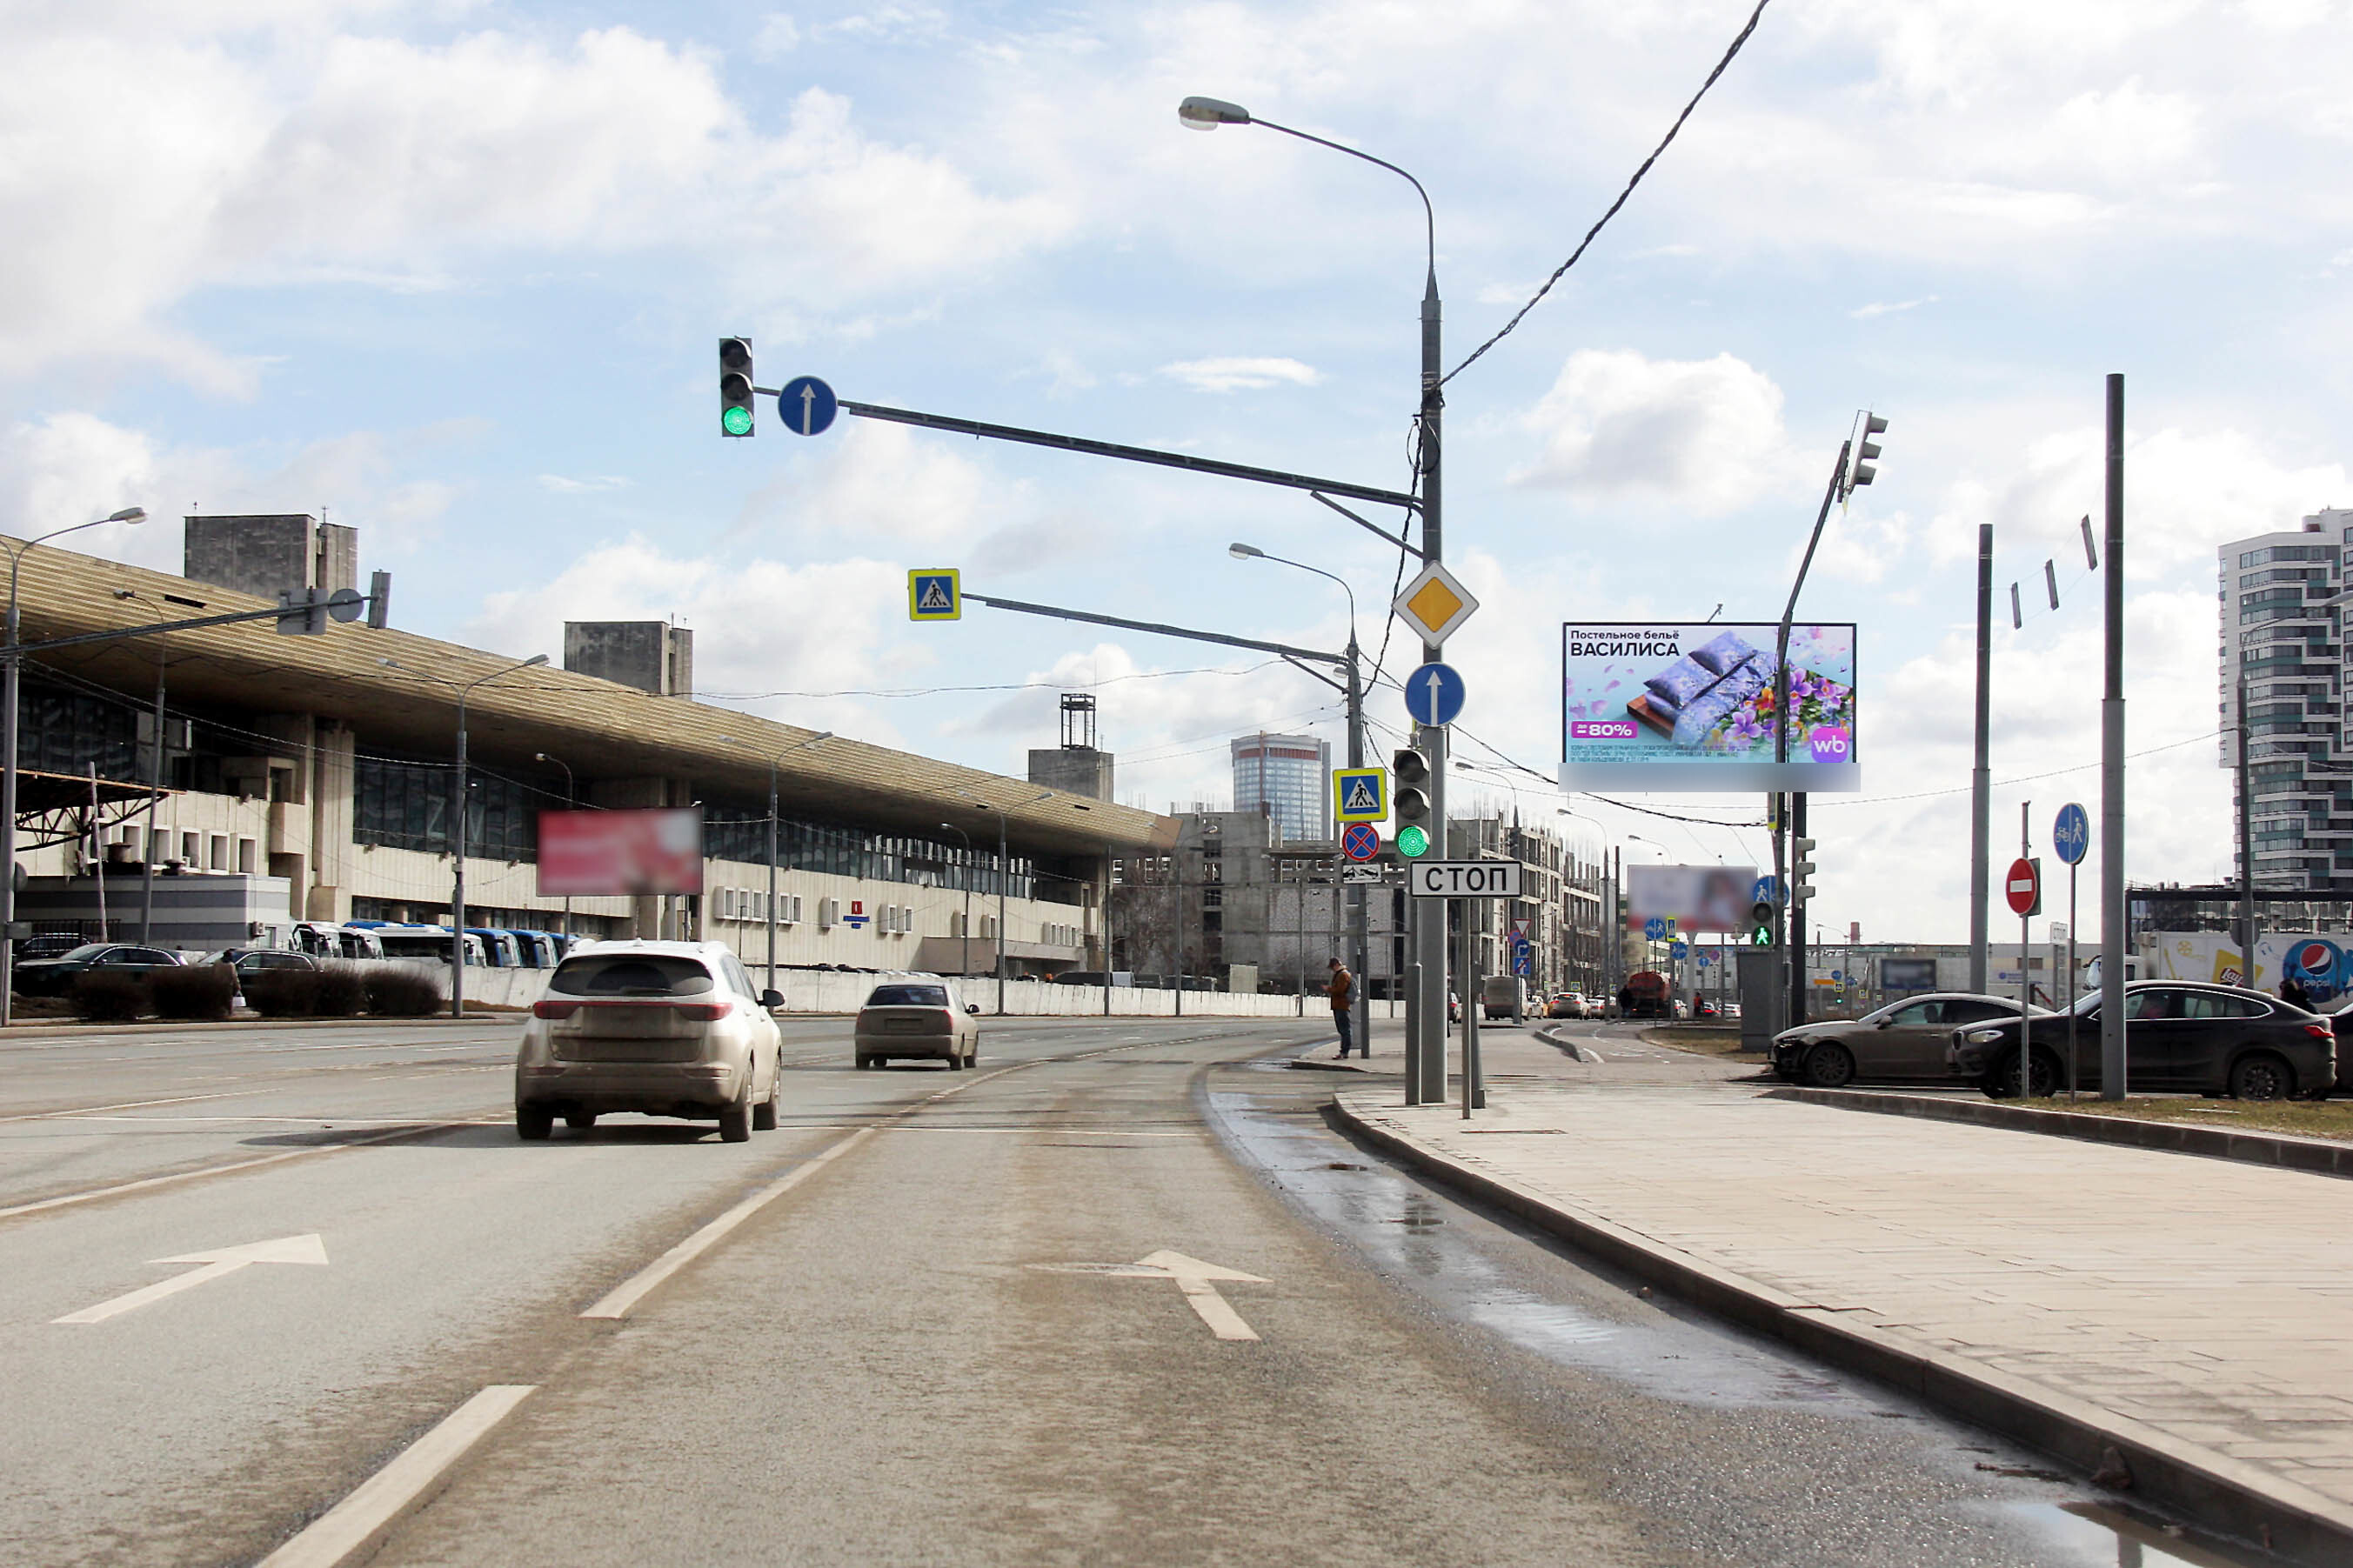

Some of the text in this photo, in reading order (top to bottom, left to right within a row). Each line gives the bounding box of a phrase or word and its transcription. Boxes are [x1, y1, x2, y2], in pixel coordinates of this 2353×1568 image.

[1571, 630, 1680, 639] Постельное бельё
[1571, 643, 1680, 656] ВАСИЛИСА
[1814, 735, 1846, 753] wb
[1425, 866, 1507, 891] СТОП
[2303, 978, 2331, 989] pepsi
